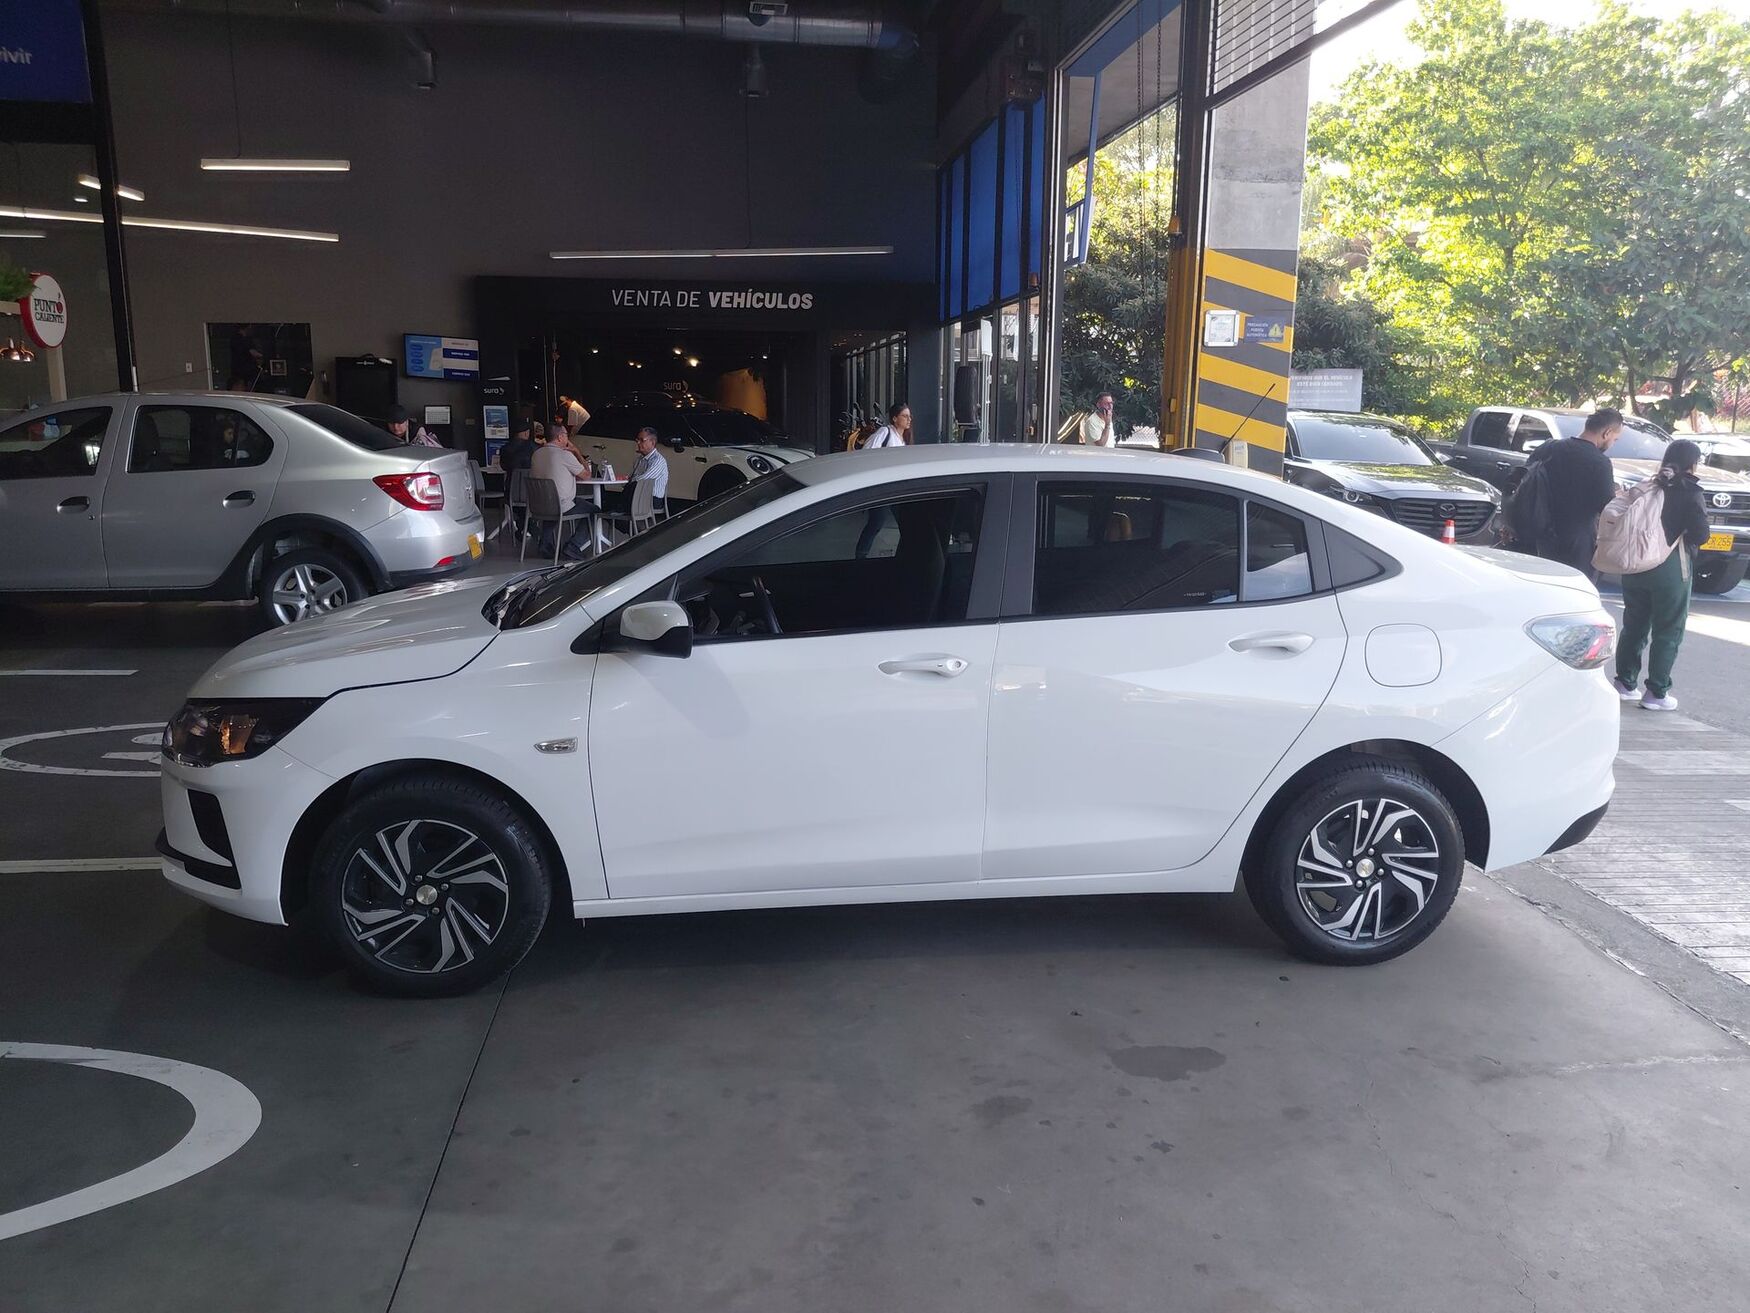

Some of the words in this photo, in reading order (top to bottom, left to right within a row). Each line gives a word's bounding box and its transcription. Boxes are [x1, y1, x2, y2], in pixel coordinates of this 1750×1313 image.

[0, 46, 33, 65] ivir
[34, 298, 64, 314] PUNTO
[611, 289, 672, 307] VENTA
[676, 291, 701, 308] DE
[708, 288, 814, 310] VEHÍCULOS
[35, 311, 65, 324] CALIENTE
[663, 381, 682, 391] sura
